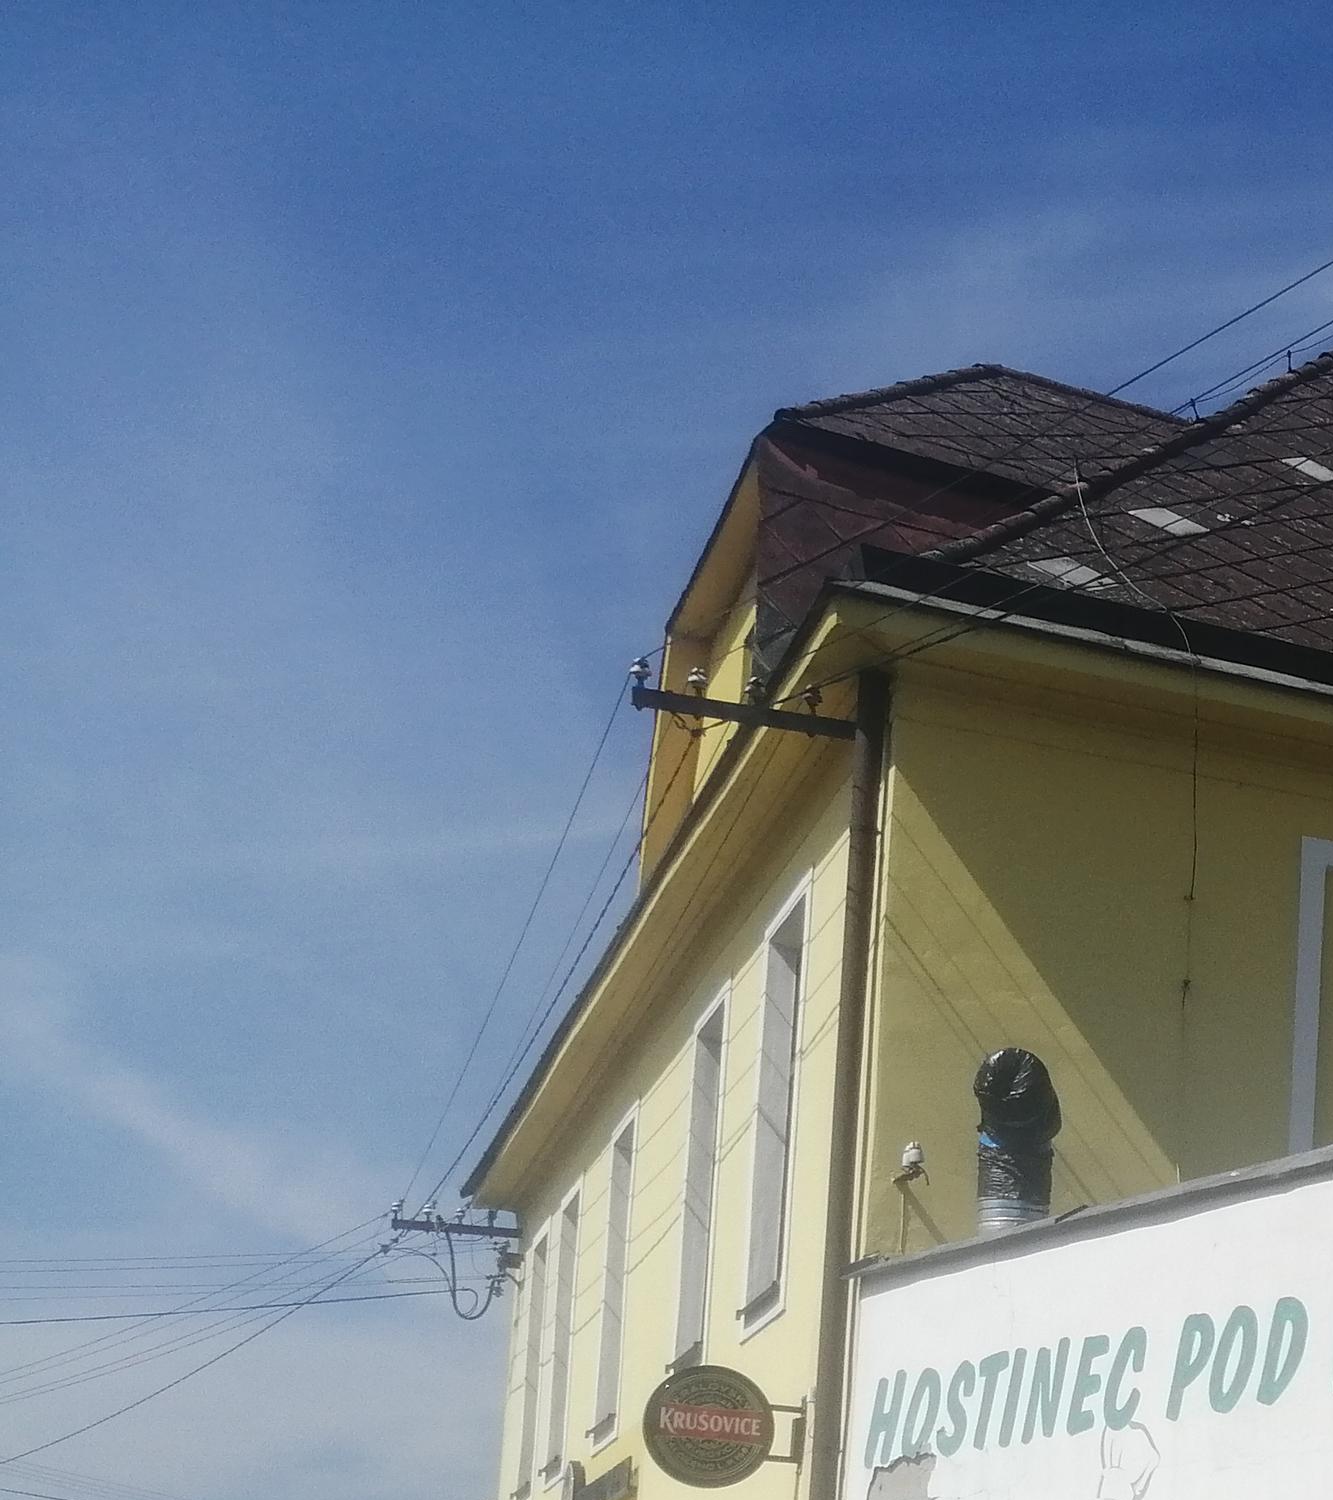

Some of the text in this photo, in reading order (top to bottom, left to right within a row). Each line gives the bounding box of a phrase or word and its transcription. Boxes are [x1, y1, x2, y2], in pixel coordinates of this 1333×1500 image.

[660, 1406, 761, 1436] KRUŠOVICE
[864, 1325, 1148, 1469] HOSTINEC
[1166, 1296, 1309, 1421] POD
